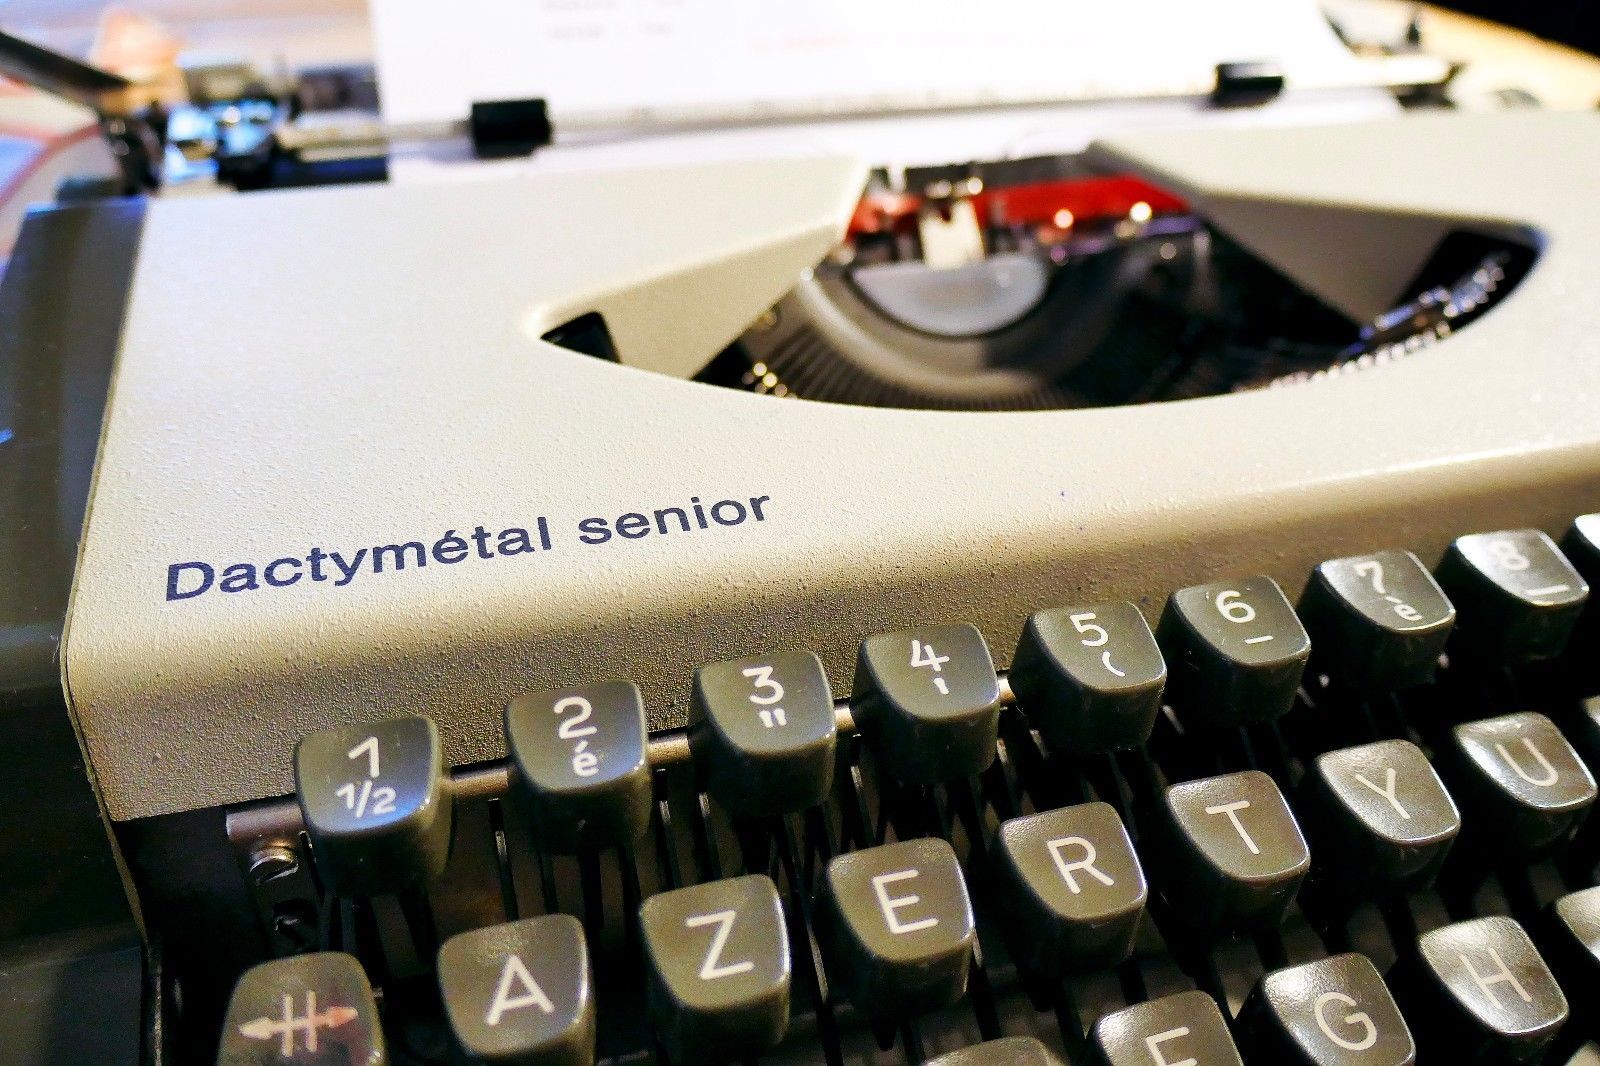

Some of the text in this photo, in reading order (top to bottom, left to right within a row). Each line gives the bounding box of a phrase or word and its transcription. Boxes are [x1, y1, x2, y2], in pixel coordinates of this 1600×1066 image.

[165, 494, 771, 602] Dactymétal senior
[1489, 541, 1531, 571] 8
[1354, 560, 1387, 595] 7
[1069, 612, 1109, 647] 5
[1214, 590, 1255, 623] 6
[910, 640, 950, 672] 4
[742, 666, 785, 705] 3
[553, 696, 597, 740] 2
[348, 736, 381, 778] 1
[572, 741, 599, 777] é
[1496, 738, 1560, 787] U
[335, 780, 397, 818] 1/2
[1355, 768, 1411, 820] Y
[1205, 800, 1261, 855] T
[1046, 836, 1114, 894] R
[872, 870, 938, 934] E
[685, 910, 755, 980] Z
[486, 954, 554, 1026] A
[1460, 948, 1533, 1010] H
[1314, 992, 1378, 1052] G
